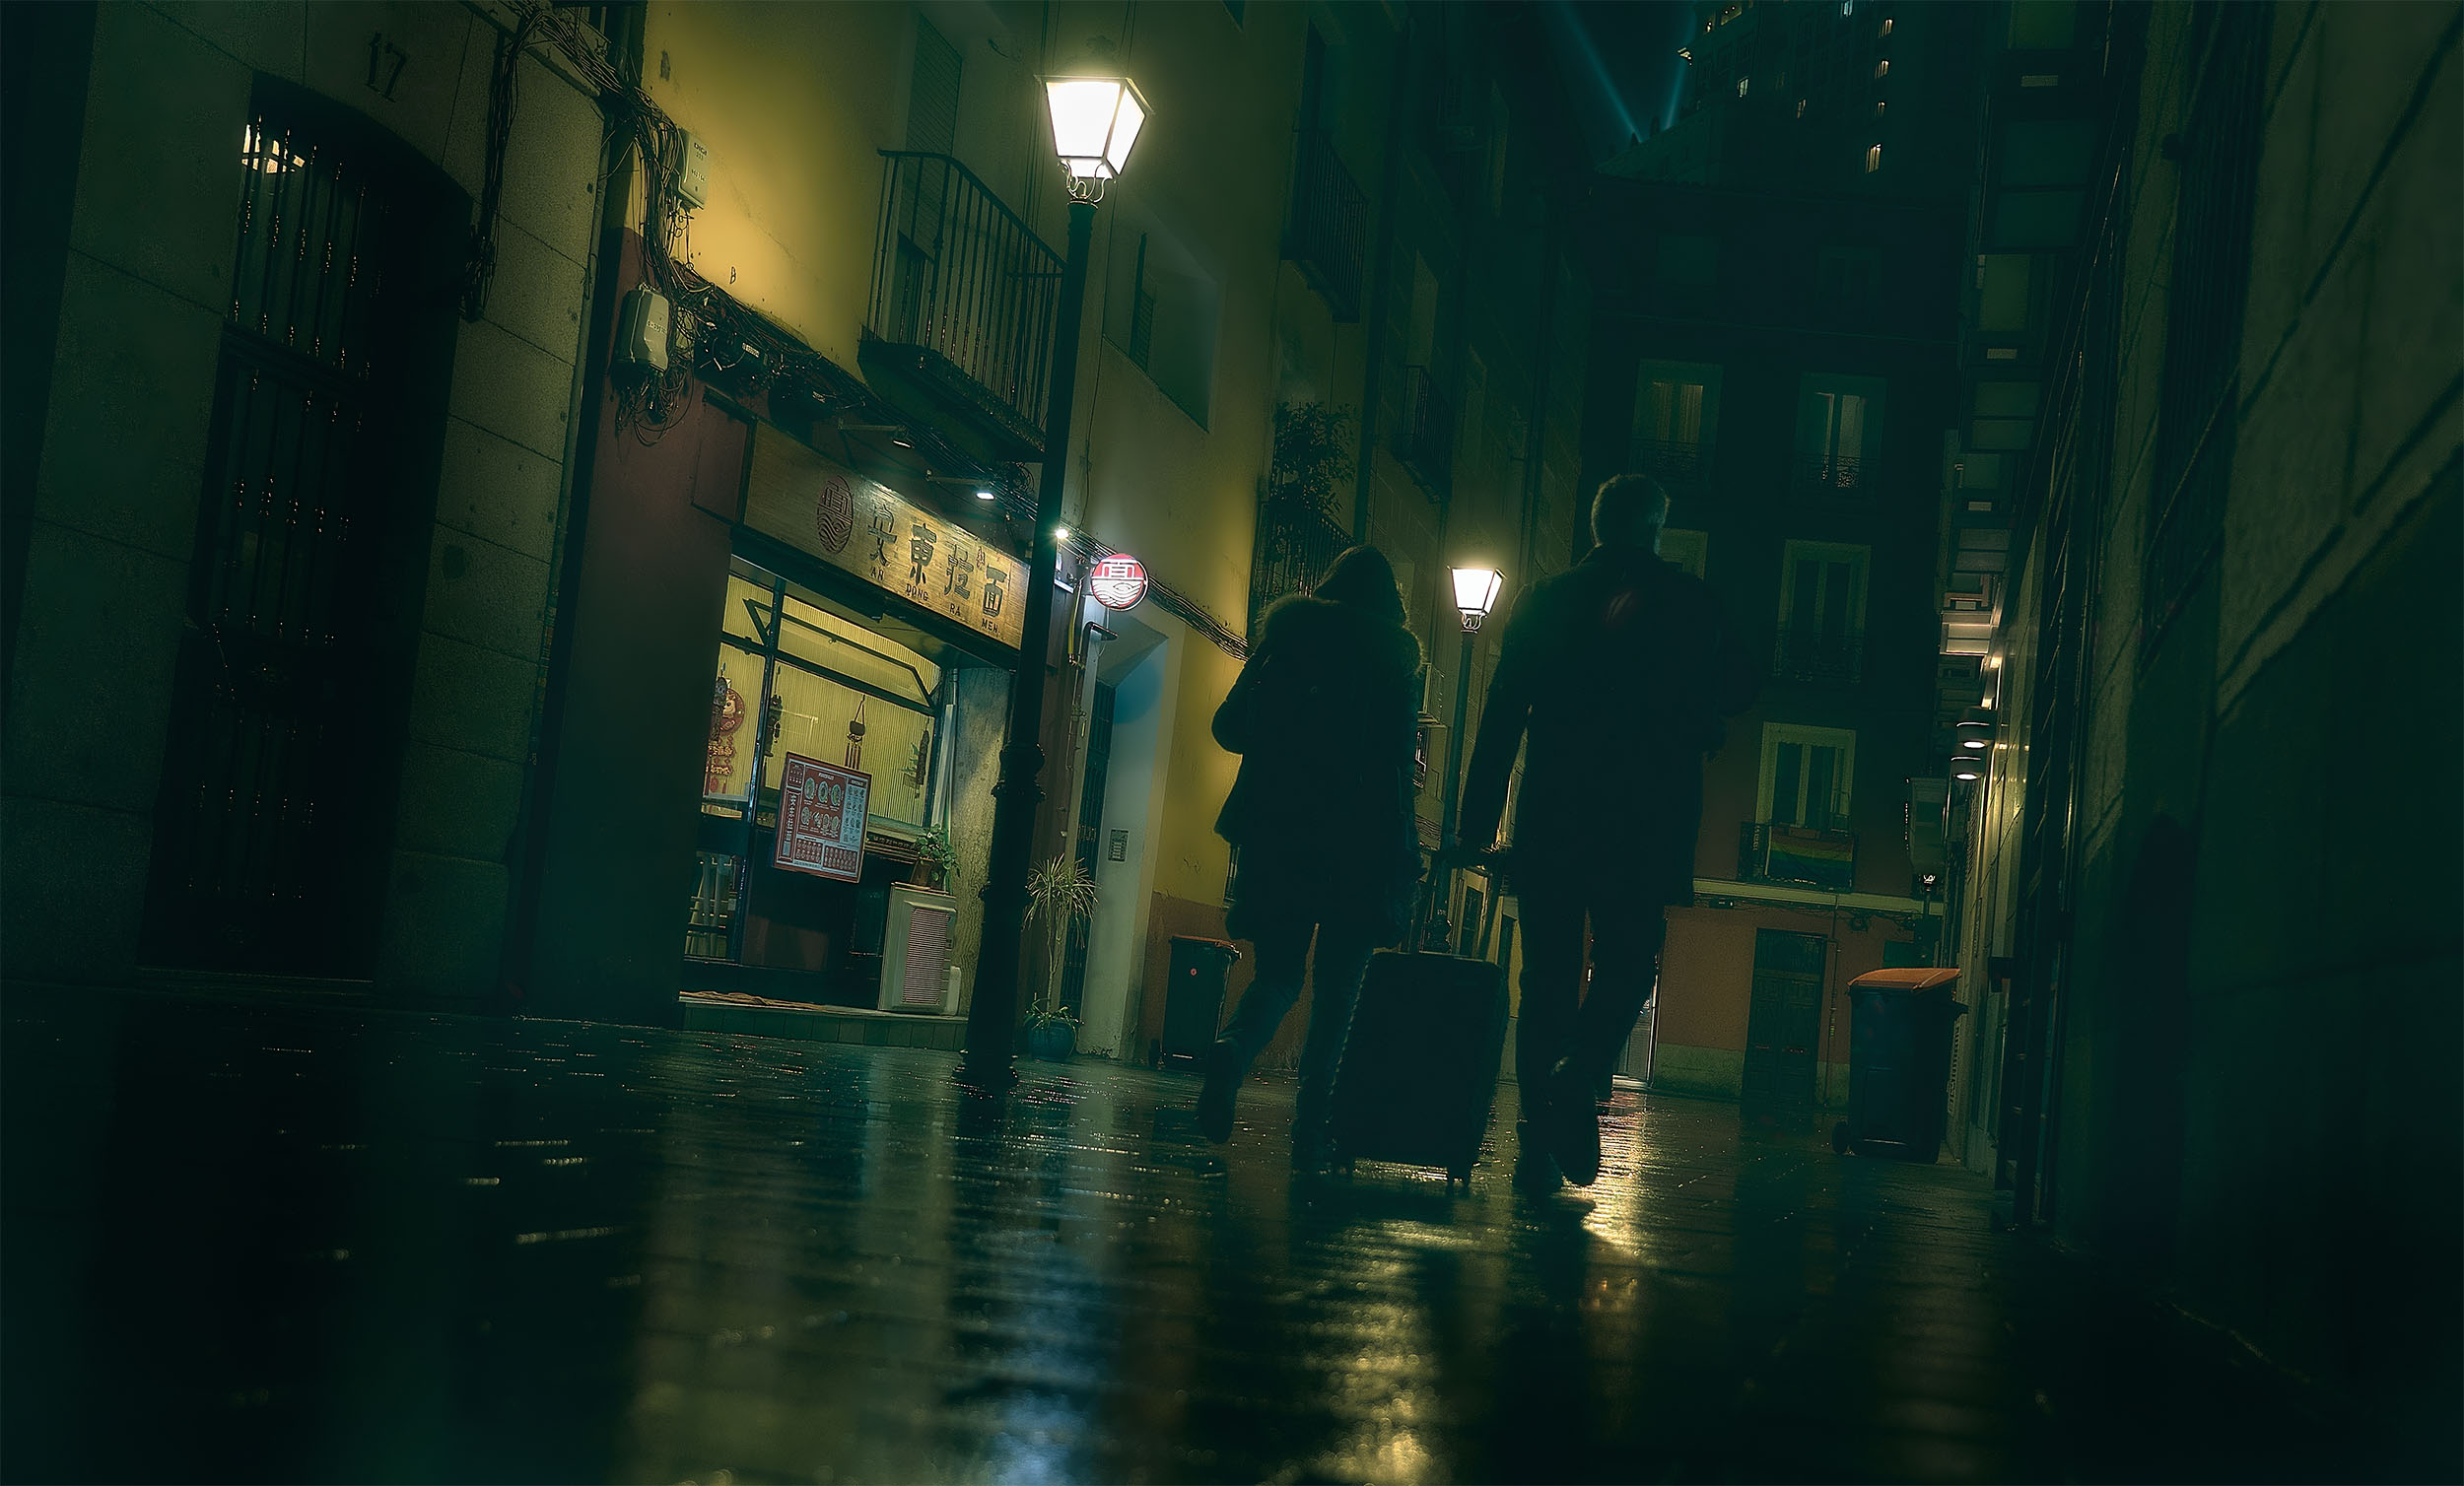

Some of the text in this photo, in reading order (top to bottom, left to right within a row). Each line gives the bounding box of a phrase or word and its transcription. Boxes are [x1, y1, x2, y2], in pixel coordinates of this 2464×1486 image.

[365, 32, 406, 102] 17
[870, 569, 998, 633] AN DONG RA MEN
